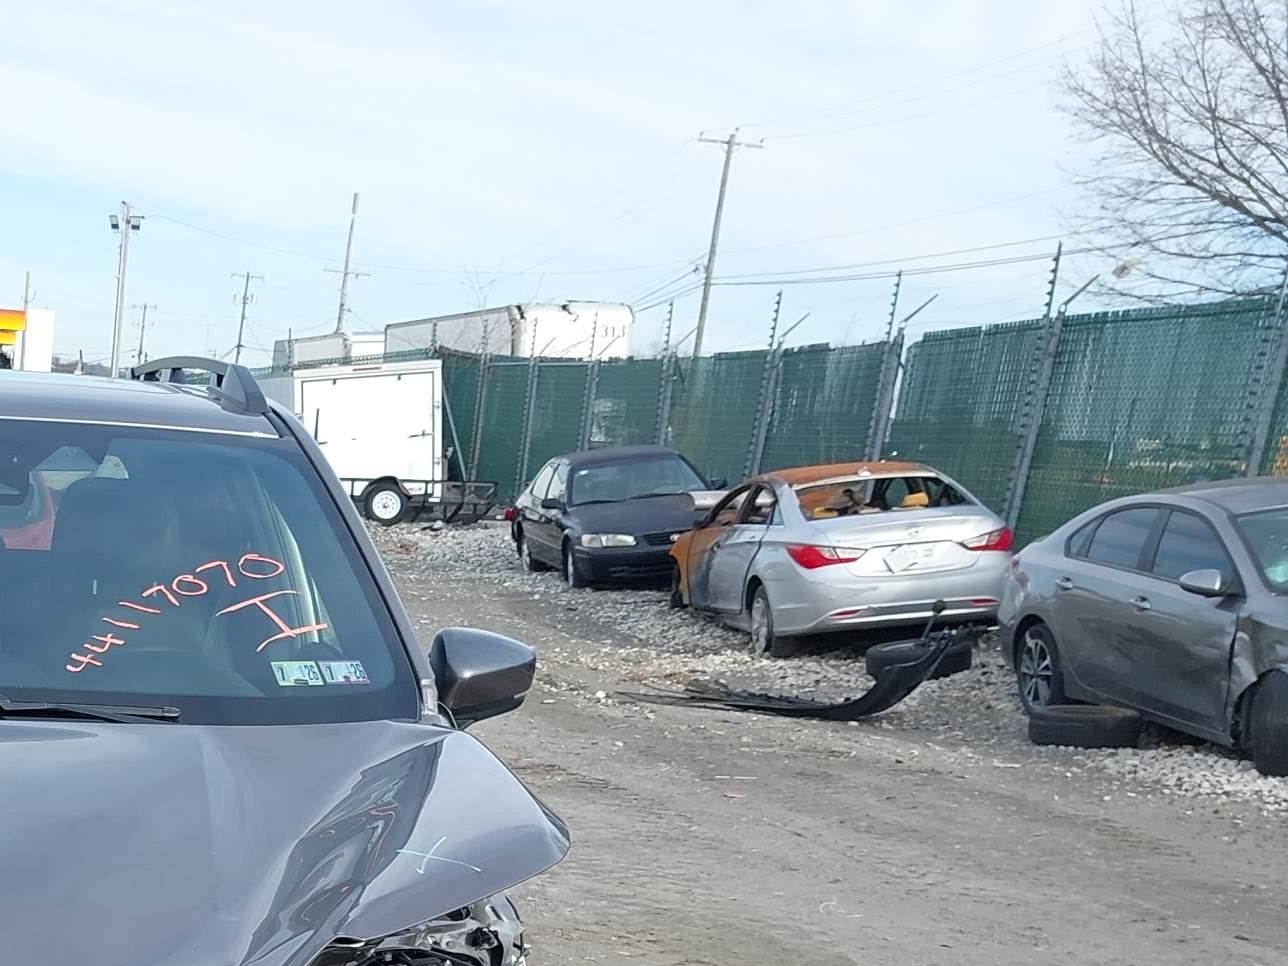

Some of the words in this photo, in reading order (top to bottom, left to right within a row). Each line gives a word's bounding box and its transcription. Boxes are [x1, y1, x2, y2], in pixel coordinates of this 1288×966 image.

[65, 553, 286, 673] 44117070
[304, 664, 319, 681] 26
[350, 663, 367, 680] 26
